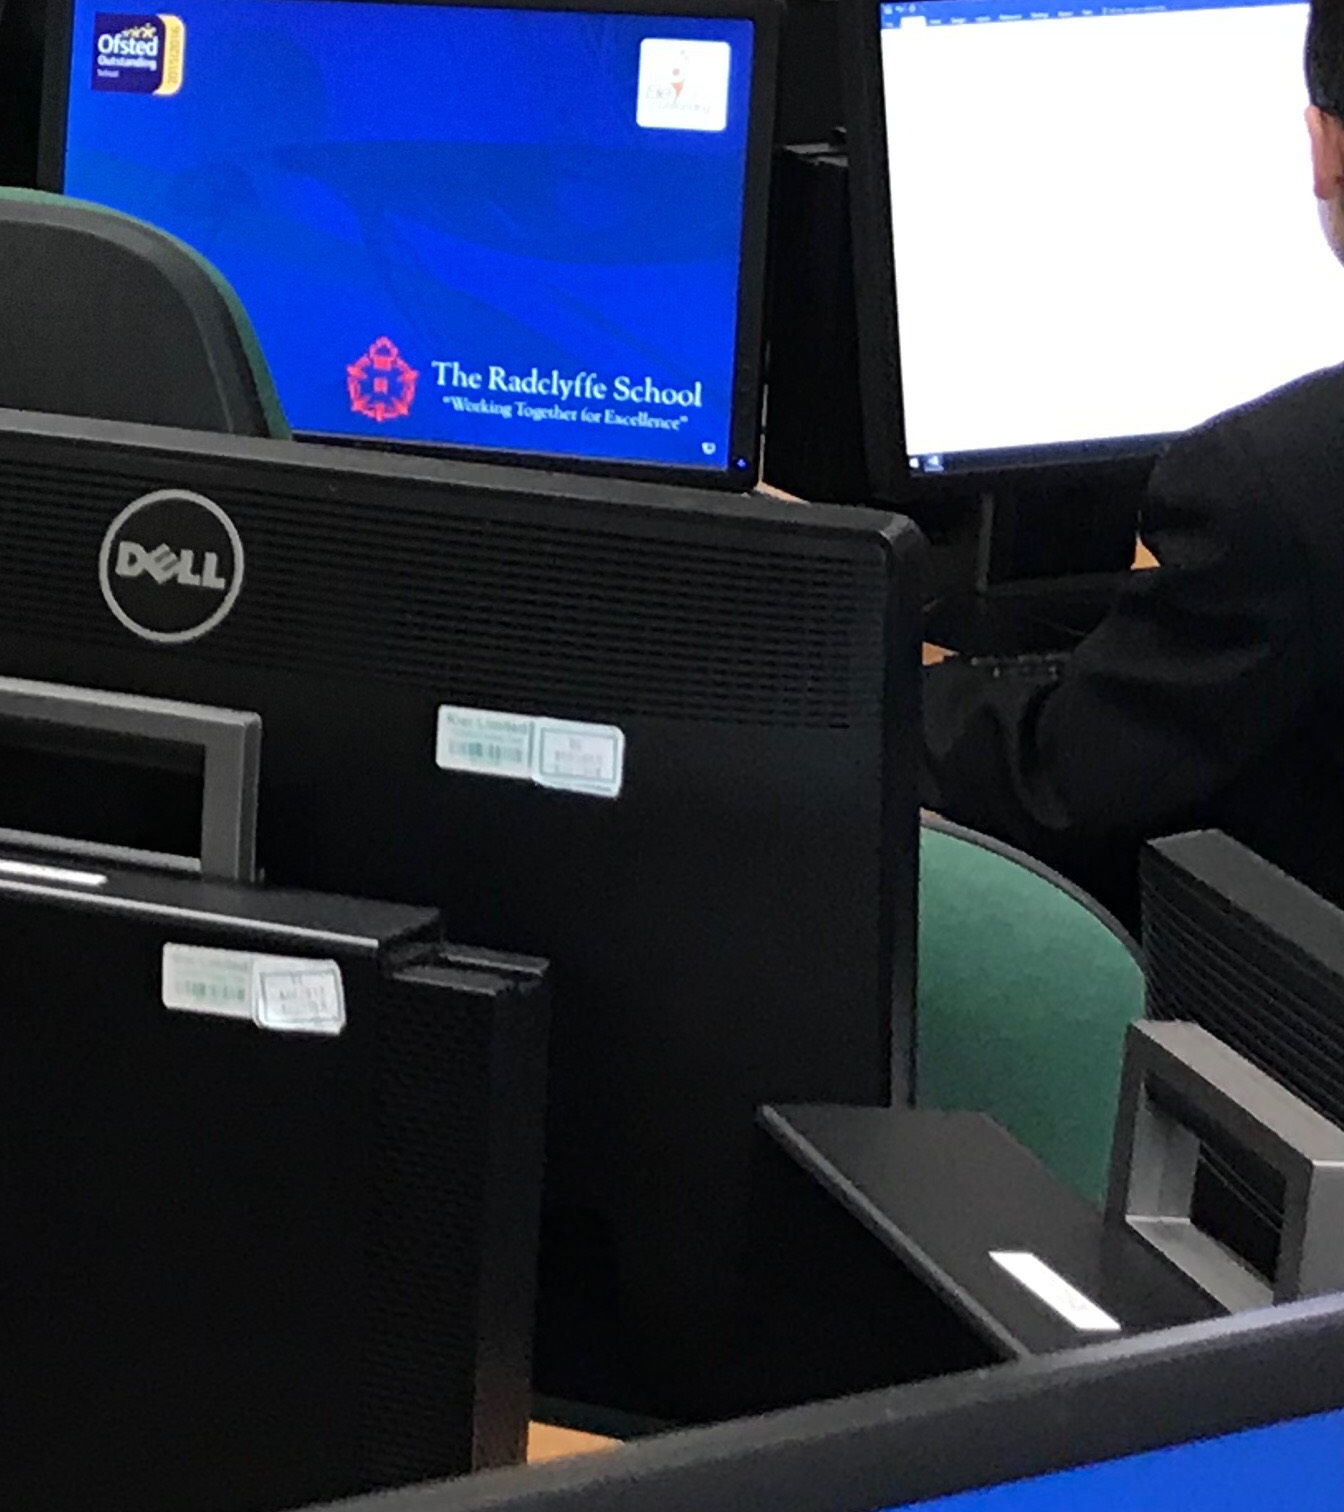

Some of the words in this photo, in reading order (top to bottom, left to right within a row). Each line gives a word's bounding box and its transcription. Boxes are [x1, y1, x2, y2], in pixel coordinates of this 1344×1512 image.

[97, 33, 158, 56] Ofsted
[97, 54, 157, 71] Outstanding
[431, 360, 482, 389] The
[488, 366, 607, 400] Radclyffe
[613, 375, 702, 407] School
[514, 401, 577, 422] Together
[581, 407, 602, 424] for
[115, 541, 226, 589] DELL
